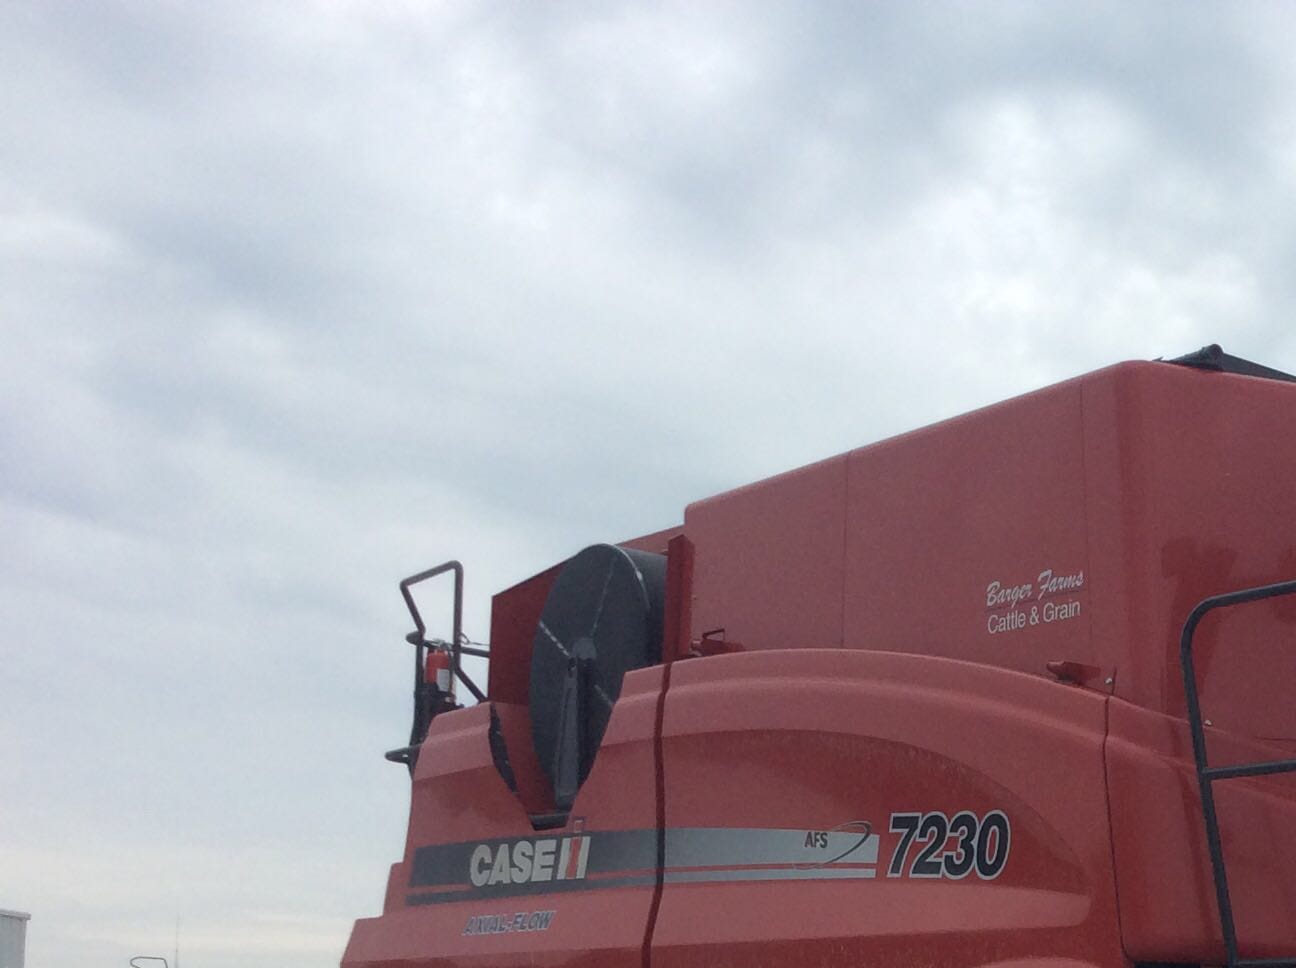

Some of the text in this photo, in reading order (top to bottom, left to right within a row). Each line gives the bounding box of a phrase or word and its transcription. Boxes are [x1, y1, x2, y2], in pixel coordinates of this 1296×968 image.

[986, 569, 1084, 608] Barger Farms
[987, 600, 1081, 634] Cattle & Grain
[804, 831, 828, 849] AFS
[887, 810, 1010, 880] 7230
